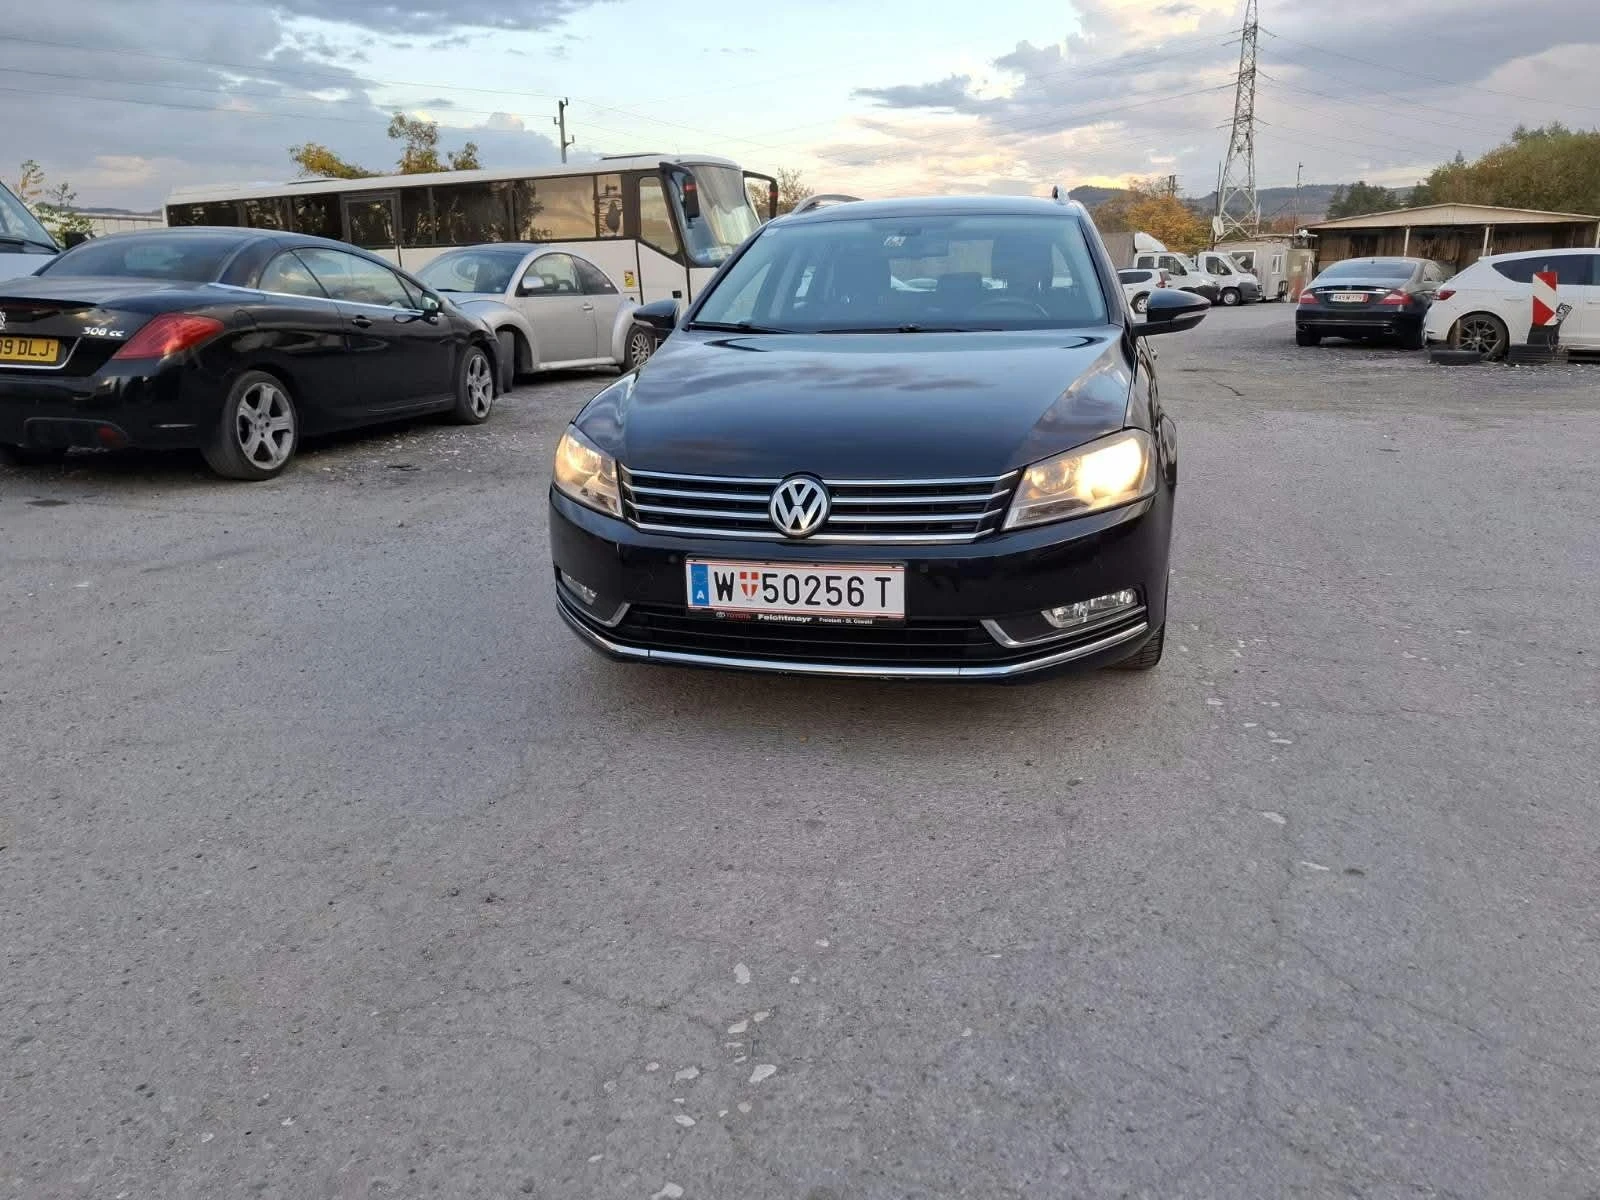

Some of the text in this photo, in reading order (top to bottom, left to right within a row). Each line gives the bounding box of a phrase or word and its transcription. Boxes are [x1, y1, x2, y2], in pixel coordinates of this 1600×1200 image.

[82, 326, 107, 336] 308
[17, 339, 50, 357] DLJ
[696, 590, 705, 600] A
[713, 571, 892, 608] W 50256 T
